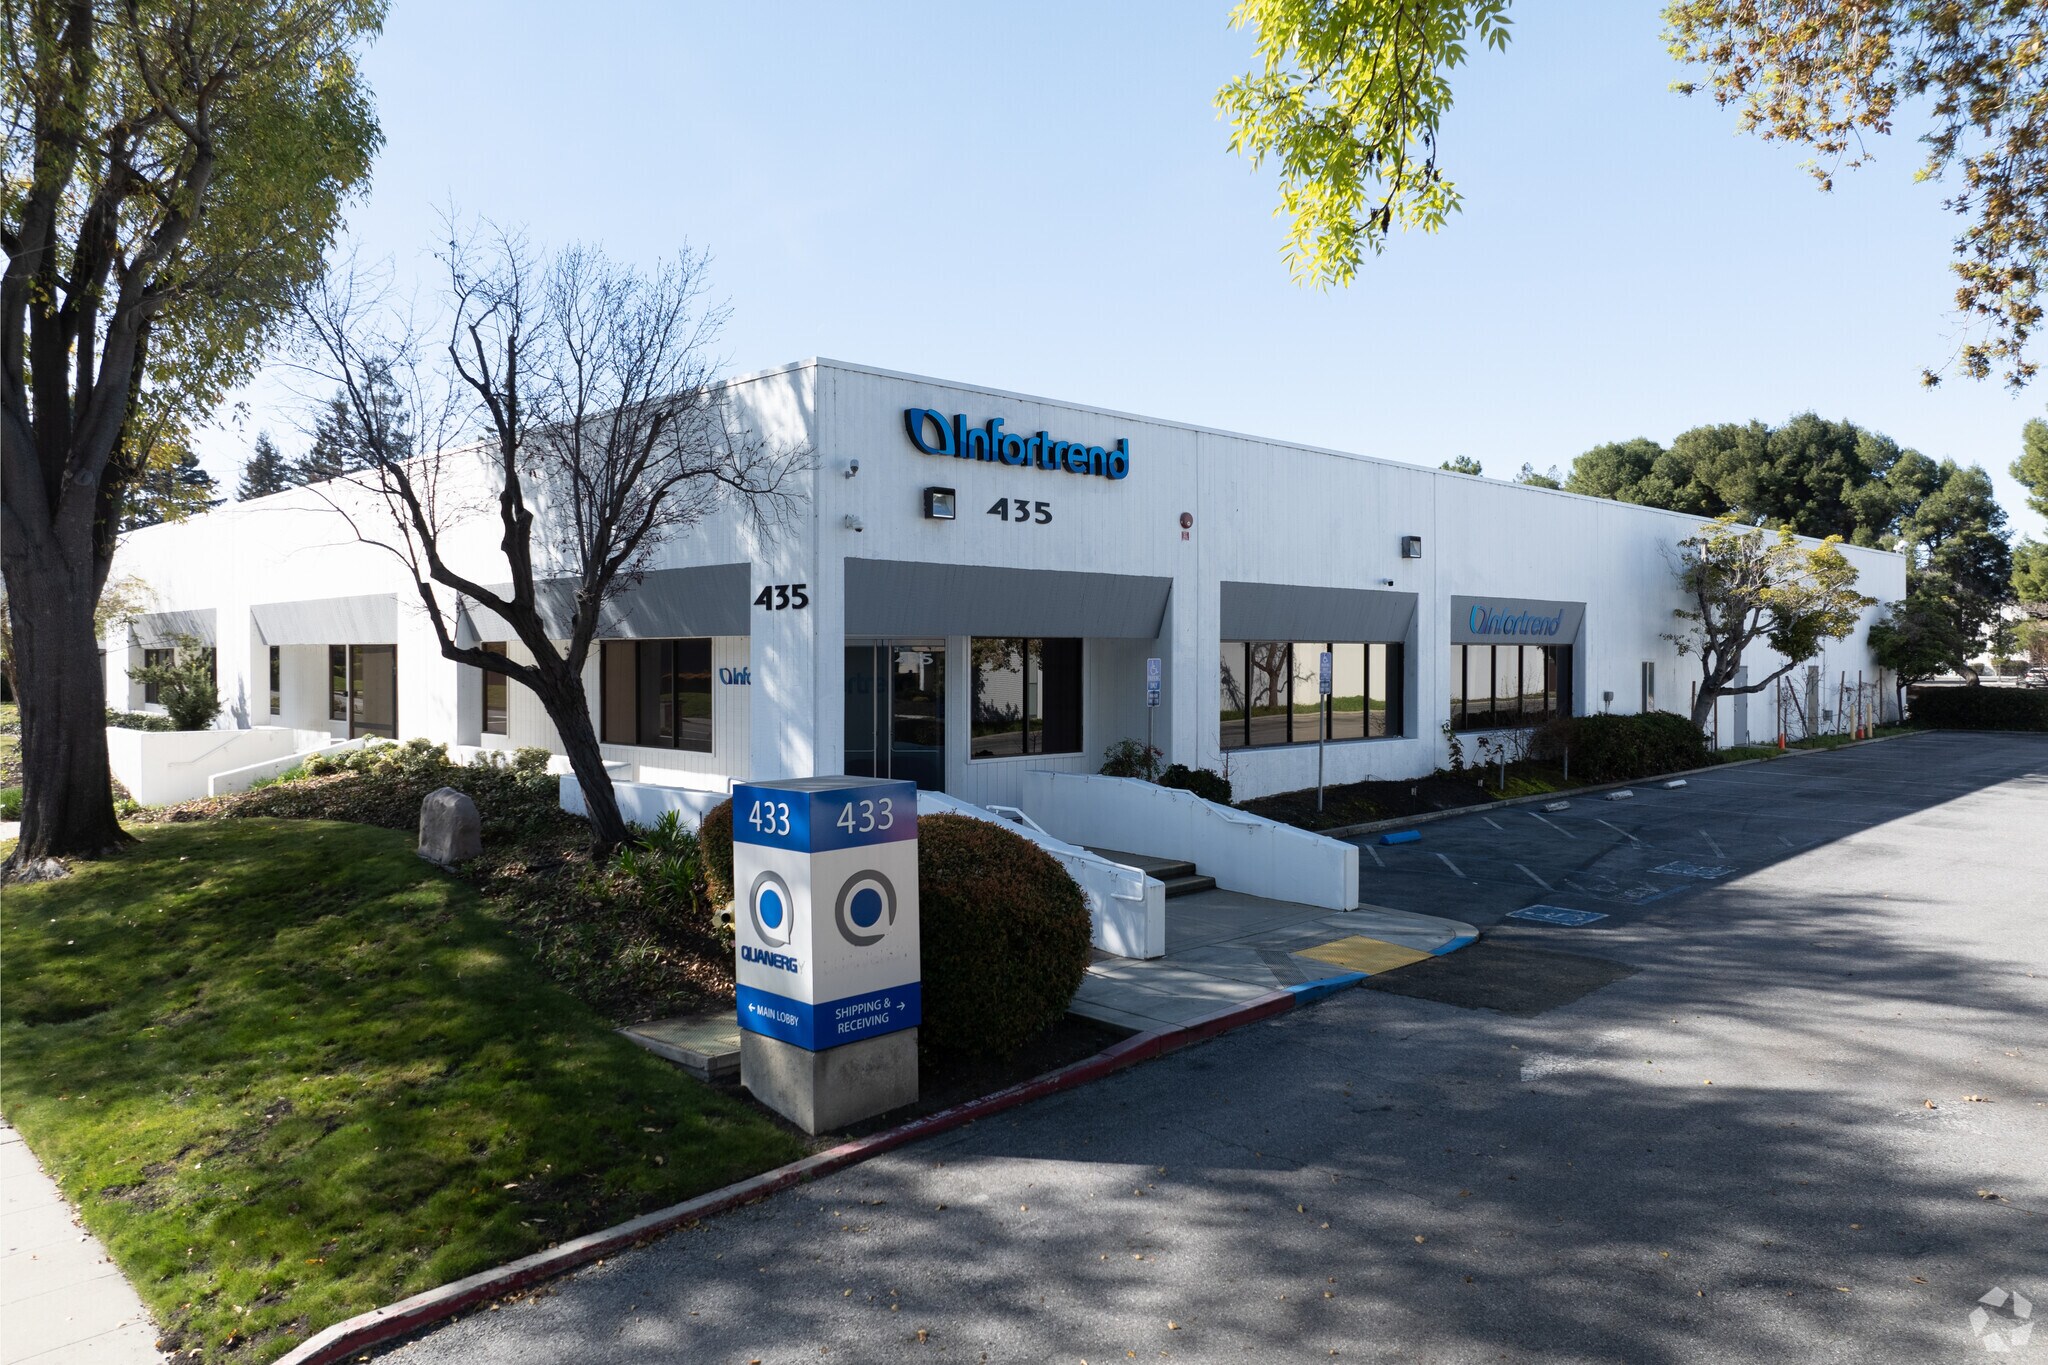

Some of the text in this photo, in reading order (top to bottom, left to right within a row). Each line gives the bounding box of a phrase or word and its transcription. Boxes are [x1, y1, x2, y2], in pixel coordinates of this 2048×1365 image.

[953, 413, 1130, 480] Infortrend
[986, 497, 1053, 524] 435
[753, 584, 809, 611] 435
[1486, 607, 1565, 636] Infortrend
[748, 800, 791, 836] 433
[836, 797, 894, 834] 433
[756, 1004, 799, 1027] MAIN LOBBY
[835, 997, 892, 1020] SHIPPING &
[837, 1012, 890, 1034] RECEIVING
